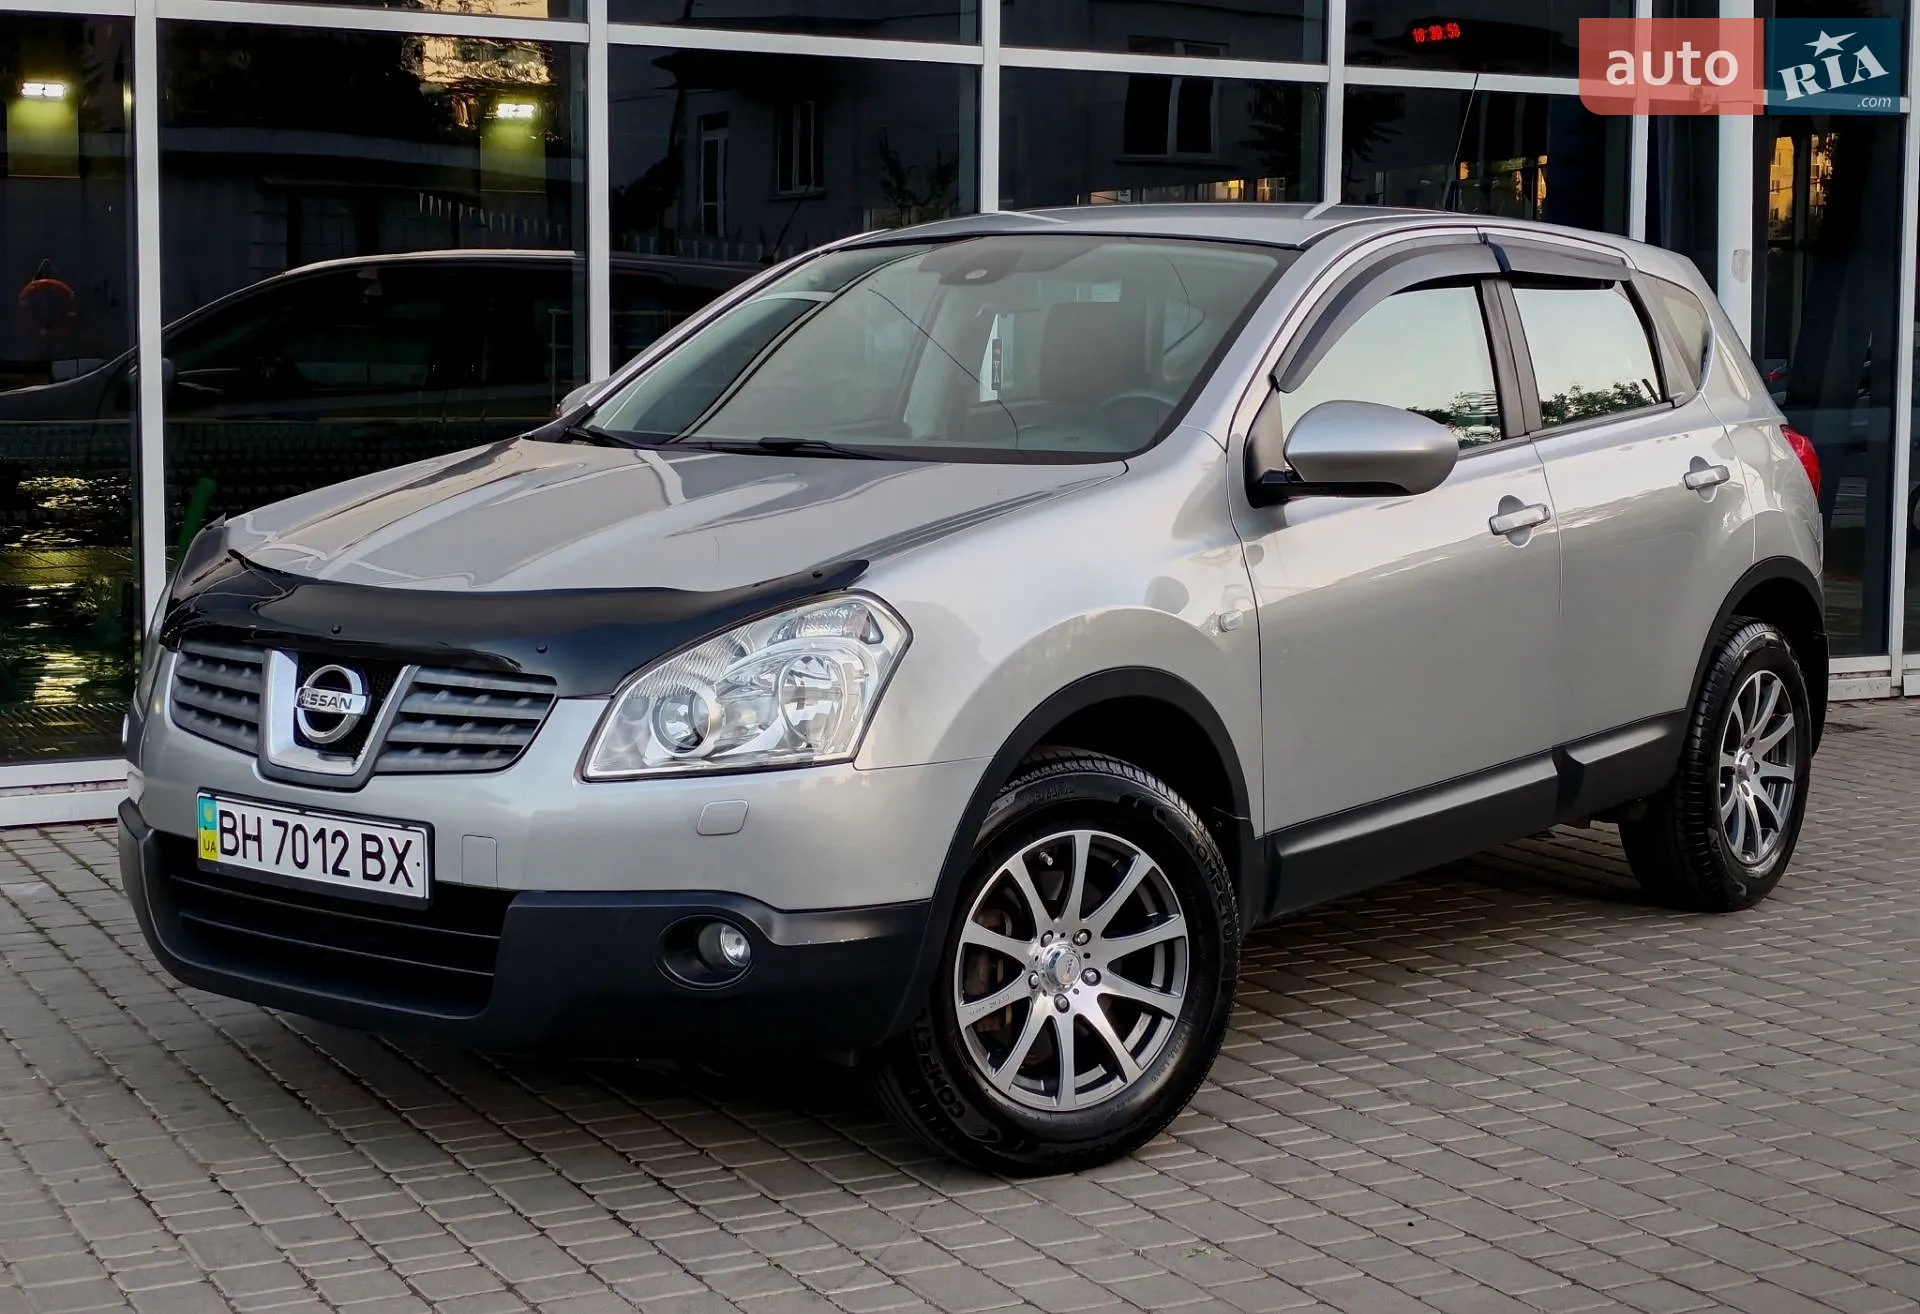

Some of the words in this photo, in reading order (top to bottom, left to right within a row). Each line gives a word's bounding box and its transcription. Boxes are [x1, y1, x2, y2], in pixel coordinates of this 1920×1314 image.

[300, 692, 353, 710] NISSAN
[203, 838, 217, 853] UA
[219, 809, 263, 862] BH
[272, 819, 350, 878] 7012
[361, 832, 414, 888] BX
